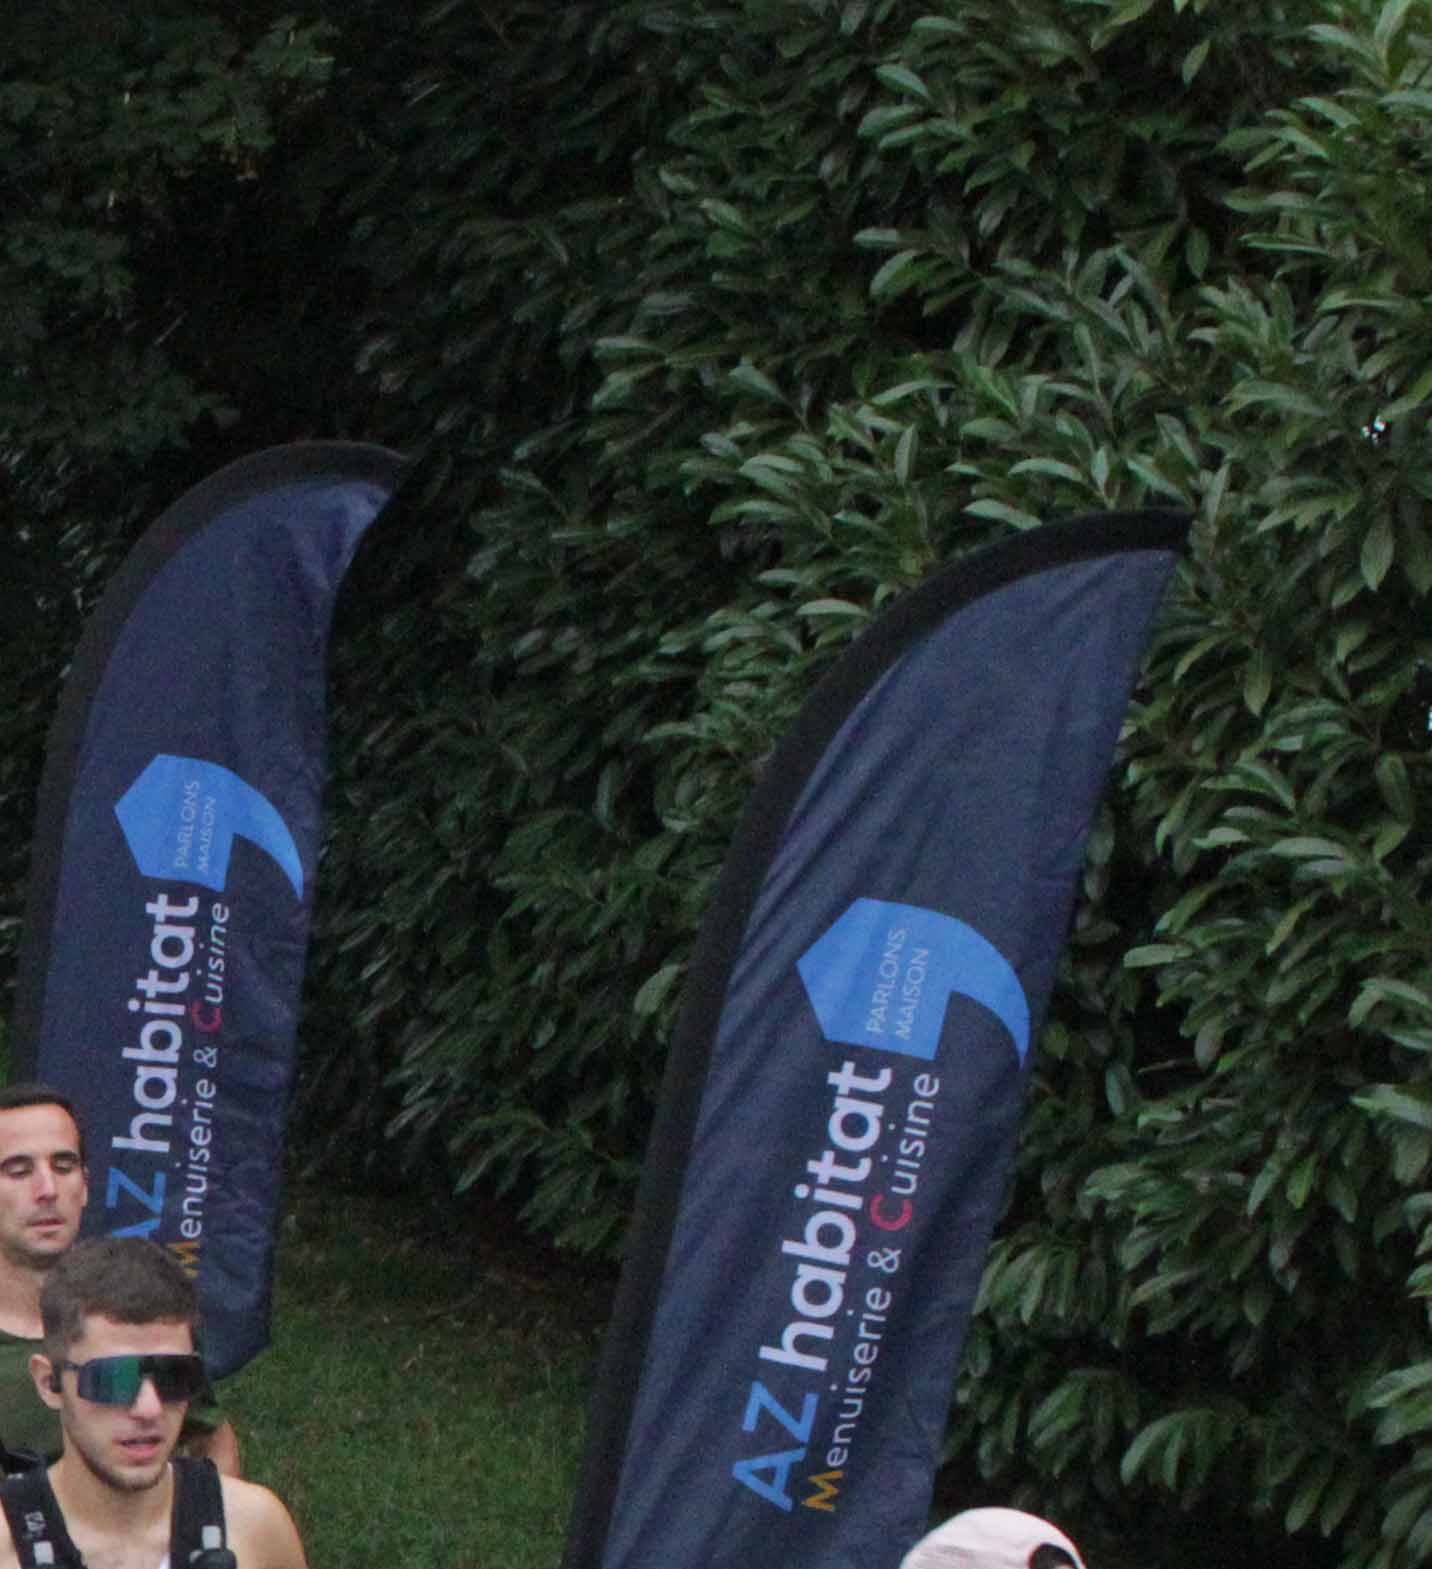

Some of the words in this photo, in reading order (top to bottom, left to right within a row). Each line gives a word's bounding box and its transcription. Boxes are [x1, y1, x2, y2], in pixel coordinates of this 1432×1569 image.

[174, 779, 201, 870] PARLONS
[111, 893, 200, 1153] habitat
[191, 902, 231, 1035] Cuisine
[865, 927, 907, 1036] PARLONS
[896, 946, 930, 1042] MAISON
[192, 1046, 219, 1069] &
[167, 1078, 219, 1280] Menuiserie
[758, 1060, 893, 1373] habitat
[869, 1071, 941, 1233] Cuisine
[868, 1246, 902, 1273] &
[731, 1380, 820, 1513] AZ
[800, 1286, 893, 1514] Menuiserie
